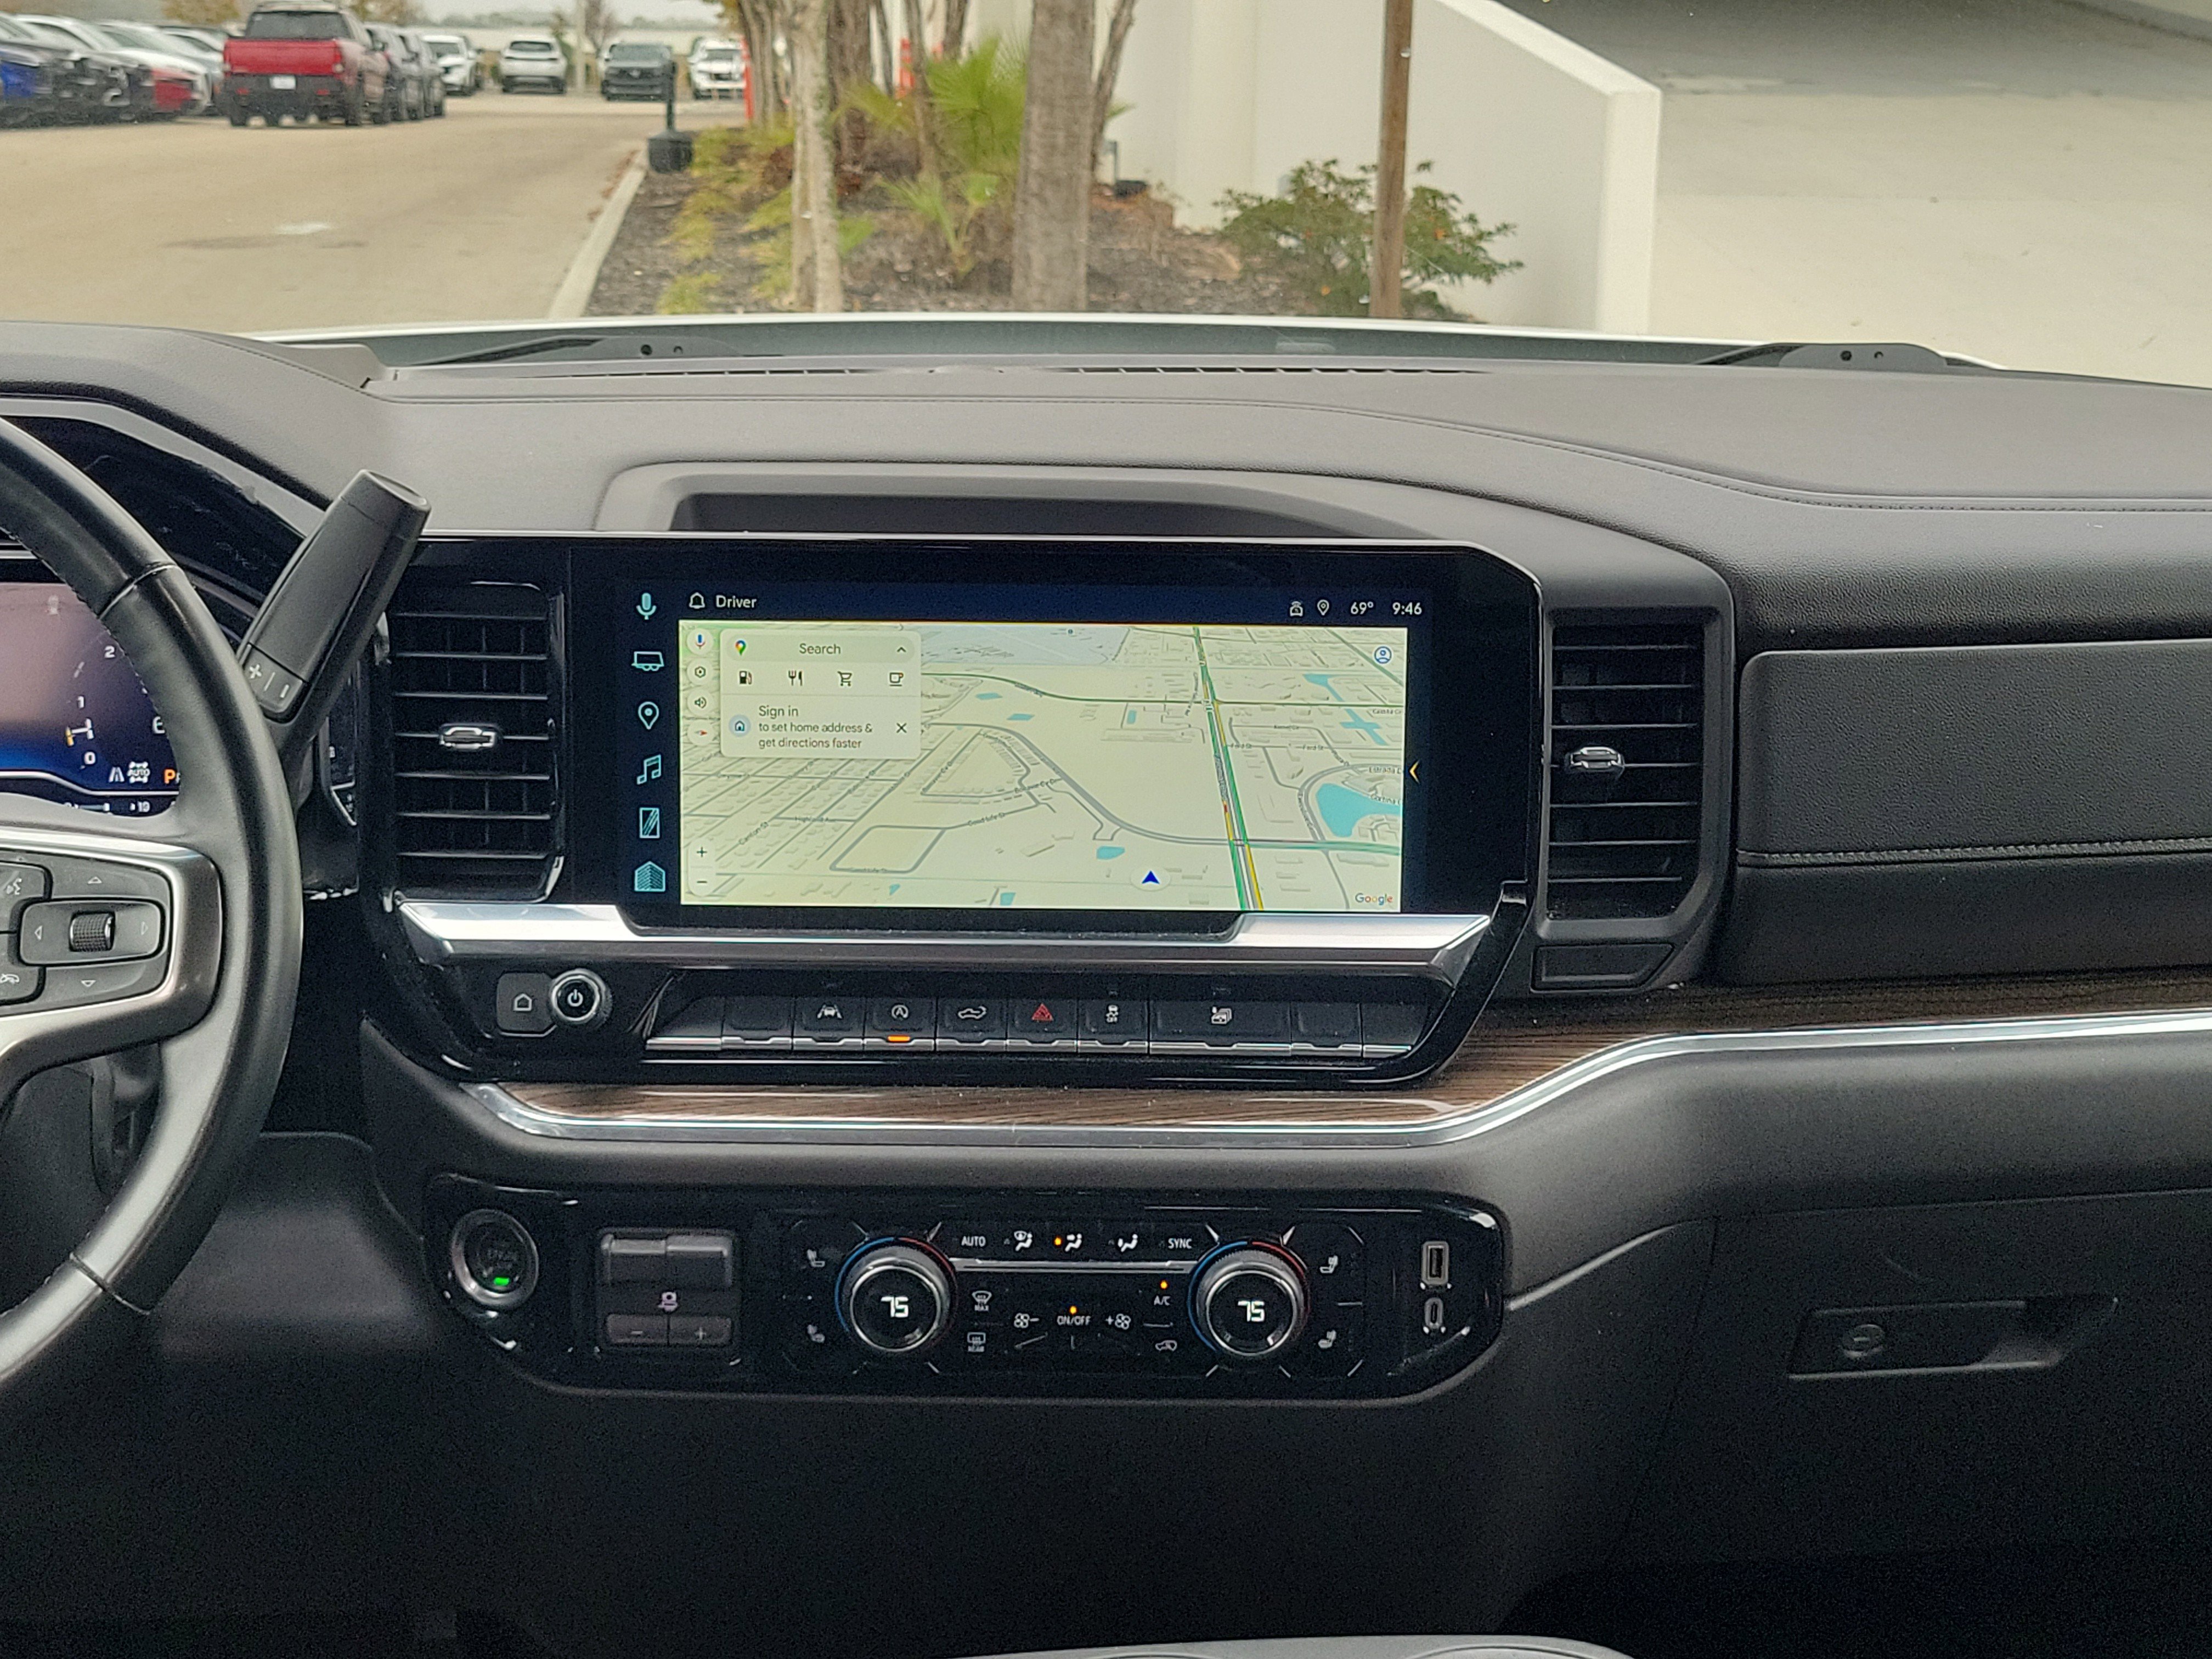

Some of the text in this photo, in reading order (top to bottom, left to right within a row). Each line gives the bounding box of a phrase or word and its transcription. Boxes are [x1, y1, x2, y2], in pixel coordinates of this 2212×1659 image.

[715, 595, 757, 608] Driver
[1392, 602, 1423, 615] 9:46
[104, 645, 115, 658] 2
[799, 643, 842, 655] Search
[77, 696, 84, 709] 1
[758, 706, 799, 719] Sign in
[759, 723, 873, 733] to set home address &
[758, 738, 862, 749] get directions faster
[84, 752, 97, 765] 0
[1355, 893, 1393, 906] Google
[961, 1235, 986, 1247] AUTO
[1168, 1238, 1192, 1249] SYNC
[880, 1296, 909, 1318] 75
[1153, 1295, 1171, 1306] A/C
[1237, 1300, 1265, 1322] 75
[1057, 1315, 1091, 1326] ON/OFF
